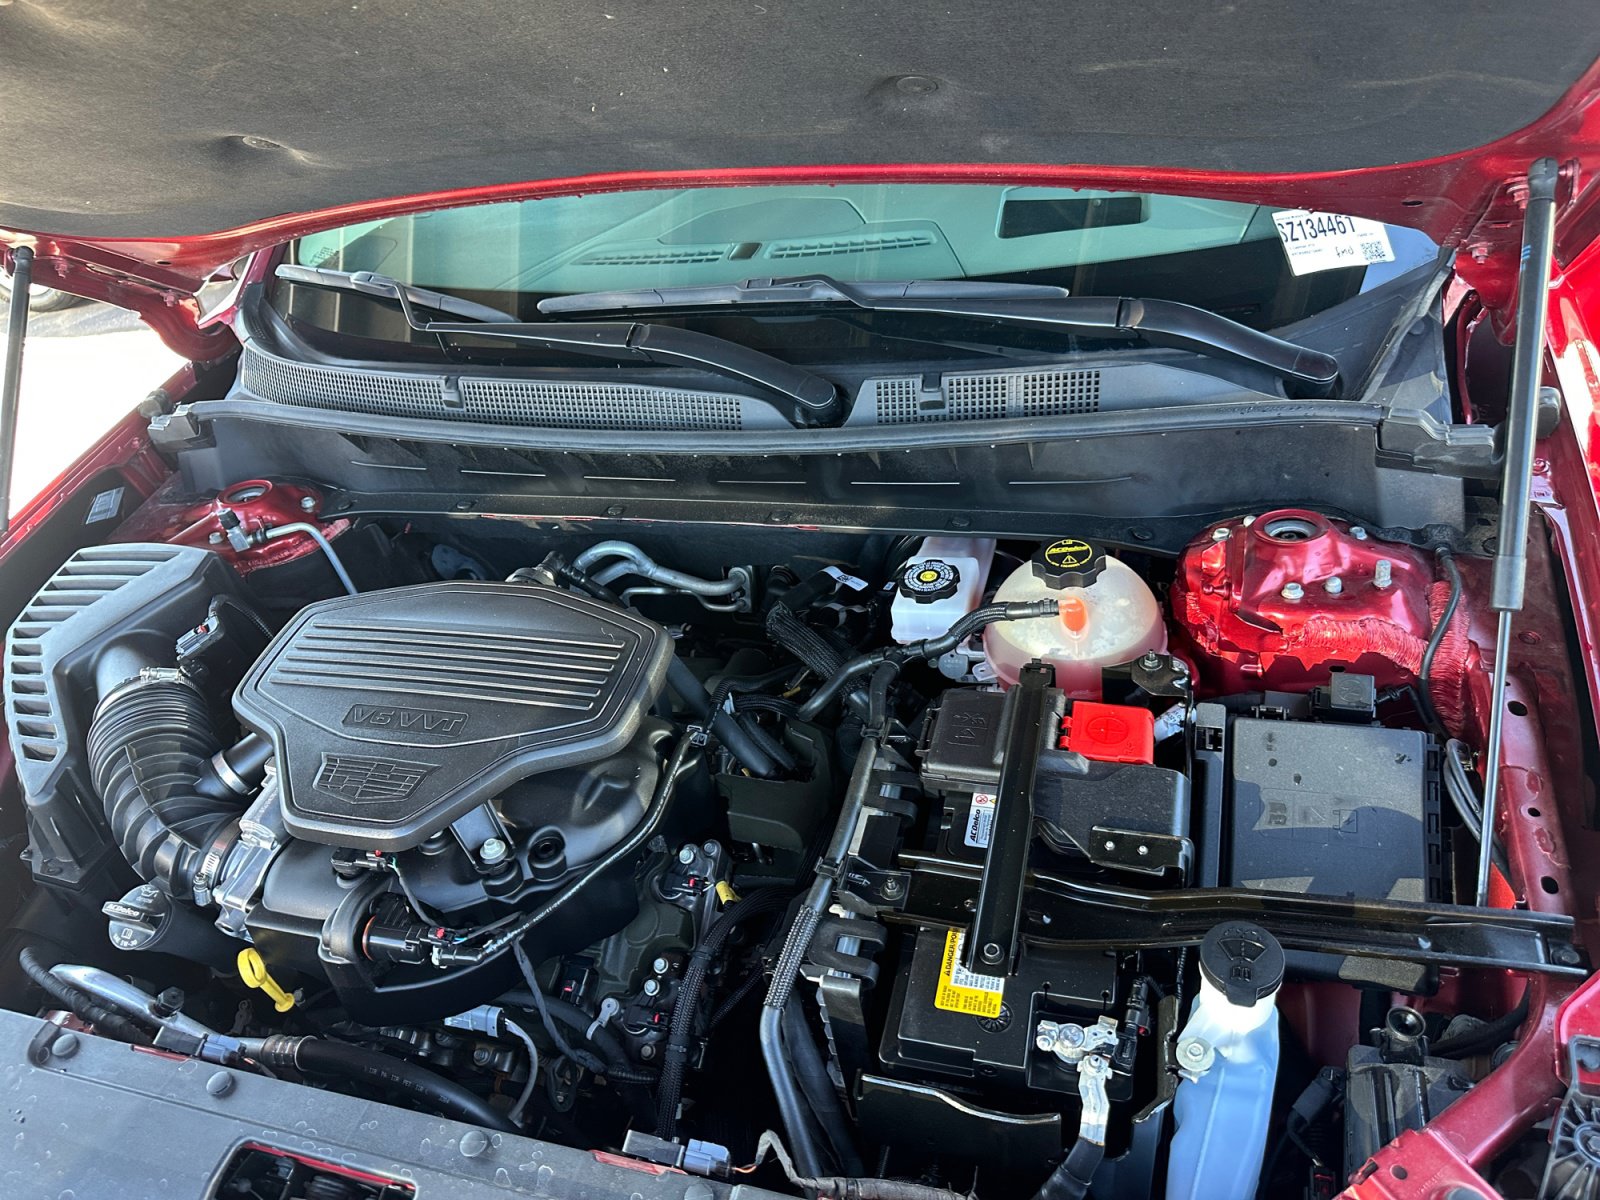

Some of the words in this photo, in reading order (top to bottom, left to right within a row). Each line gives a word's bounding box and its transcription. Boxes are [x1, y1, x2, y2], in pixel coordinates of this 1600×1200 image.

[353, 707, 395, 725] V6
[399, 711, 463, 732] VVT
[970, 809, 981, 842] ACDelco
[106, 903, 139, 917] ACDelco
